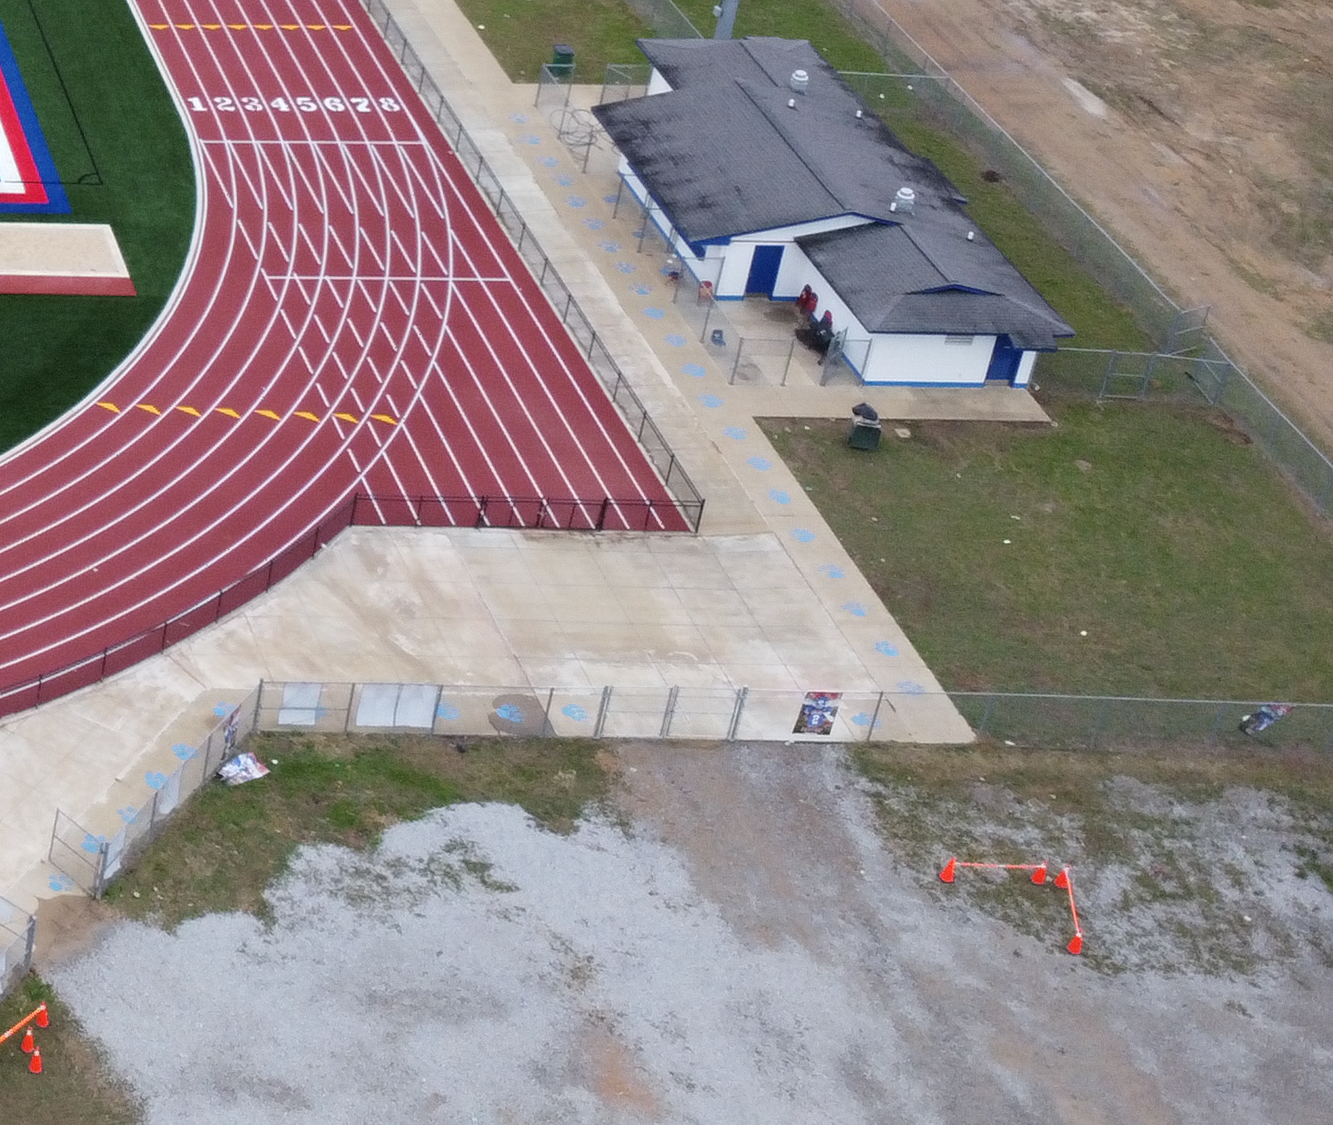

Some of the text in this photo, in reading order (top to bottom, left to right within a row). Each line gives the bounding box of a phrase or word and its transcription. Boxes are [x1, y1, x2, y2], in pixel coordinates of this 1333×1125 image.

[188, 97, 401, 112] 1 2 3 4 5 6 7 8
